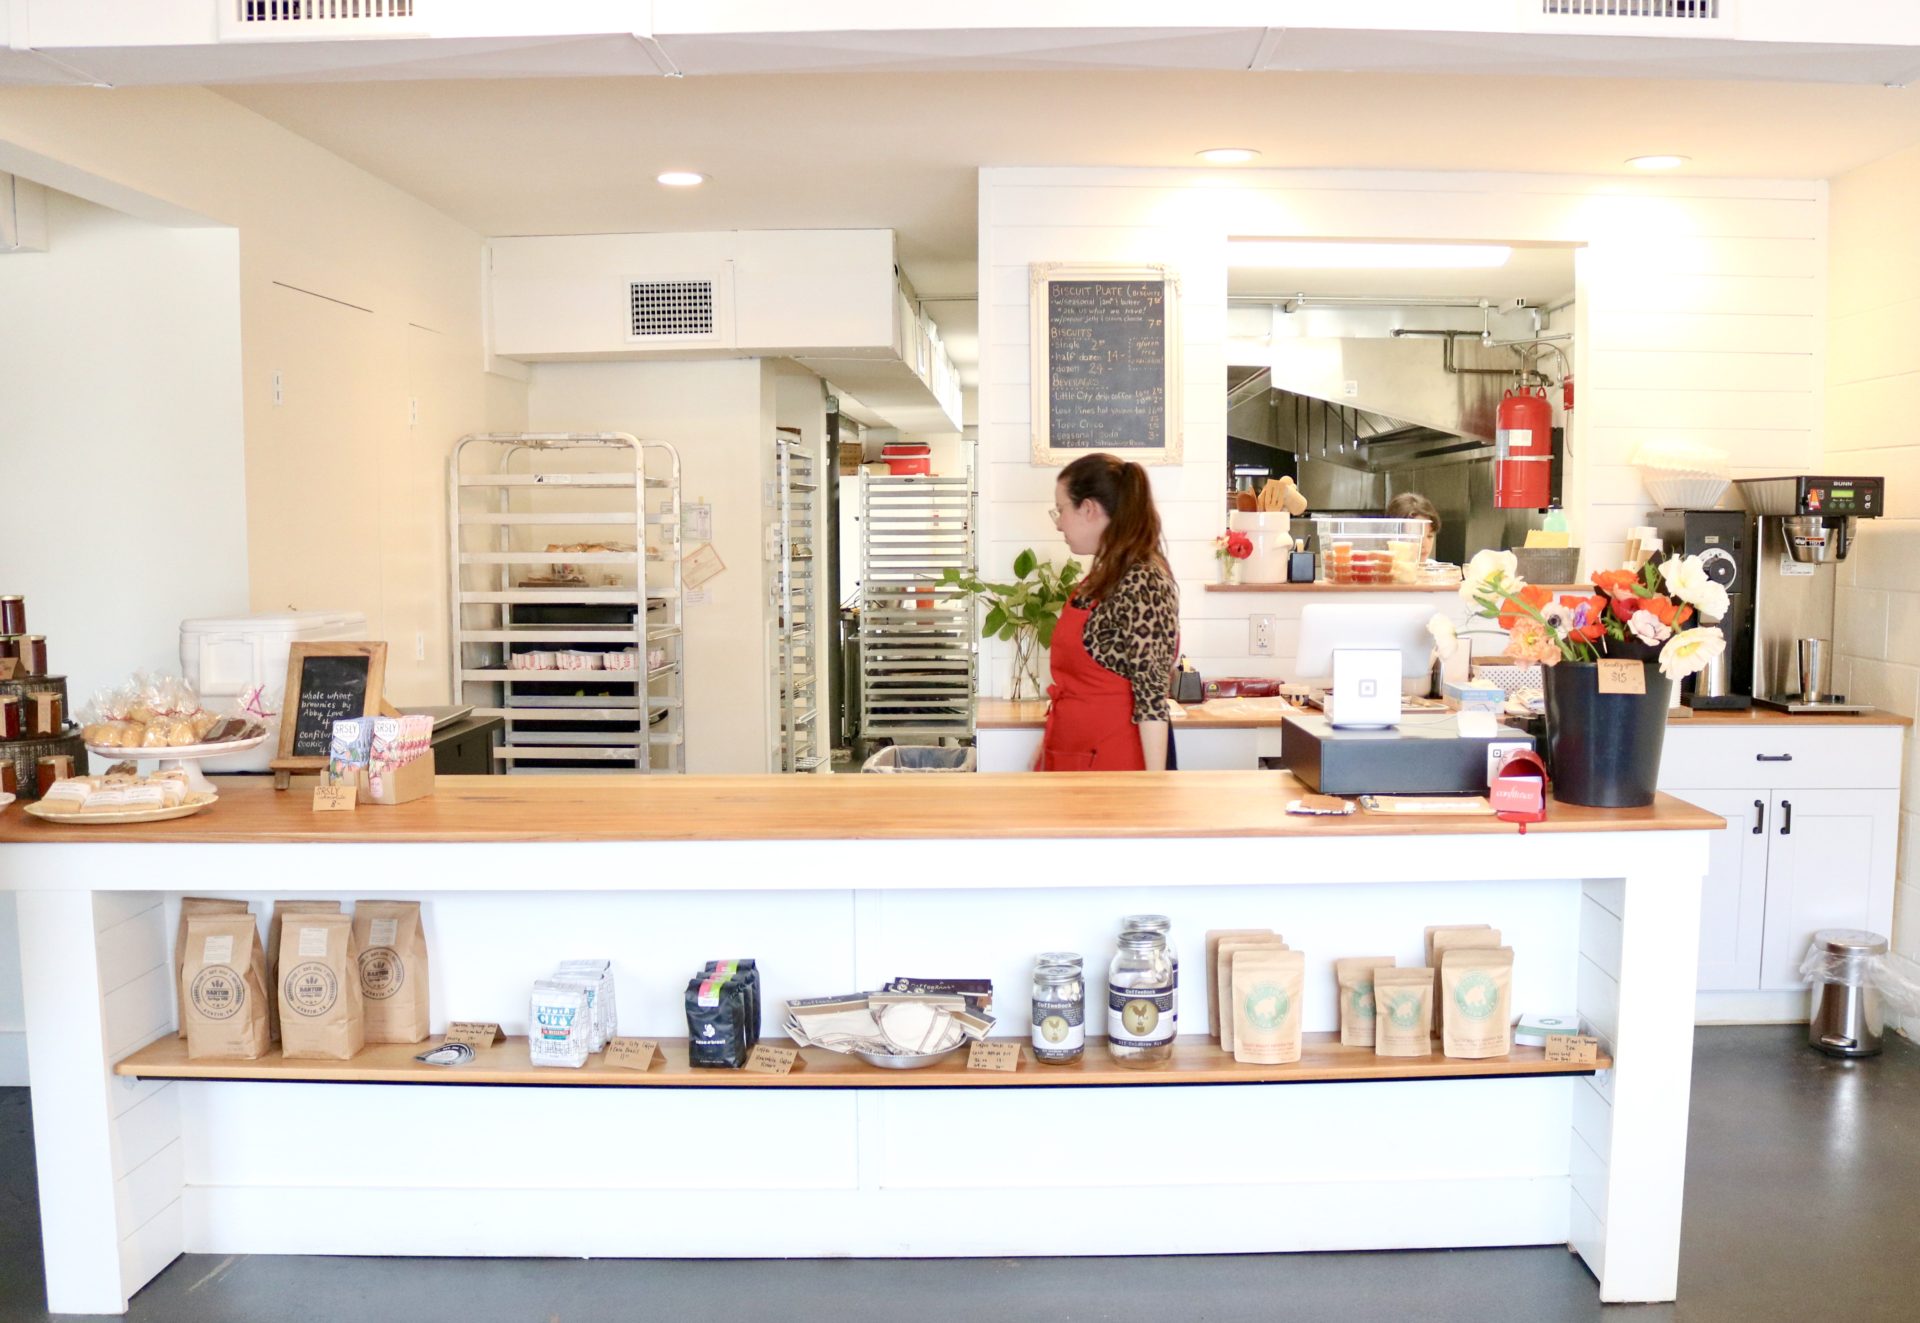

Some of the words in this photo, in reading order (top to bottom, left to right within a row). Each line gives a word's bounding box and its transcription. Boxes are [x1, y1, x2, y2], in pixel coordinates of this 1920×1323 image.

[1052, 285, 1092, 297] BISCUIT
[1095, 285, 1123, 296] PLATE
[1051, 327, 1093, 338] BISCUITS
[1055, 391, 1075, 401] Little
[1076, 391, 1093, 402] City
[1611, 672, 1627, 683] $15
[302, 690, 324, 700] whole
[327, 691, 353, 700] wheat
[301, 701, 336, 709] brownies
[342, 702, 352, 711] by
[303, 709, 323, 720] Abby
[335, 724, 357, 734] SRSLY
[375, 723, 397, 733] SRSLY
[300, 730, 332, 740] confitur
[316, 787, 339, 796] SRSLY
[536, 1006, 576, 1015] LITTLE
[537, 1014, 574, 1026] CITY
